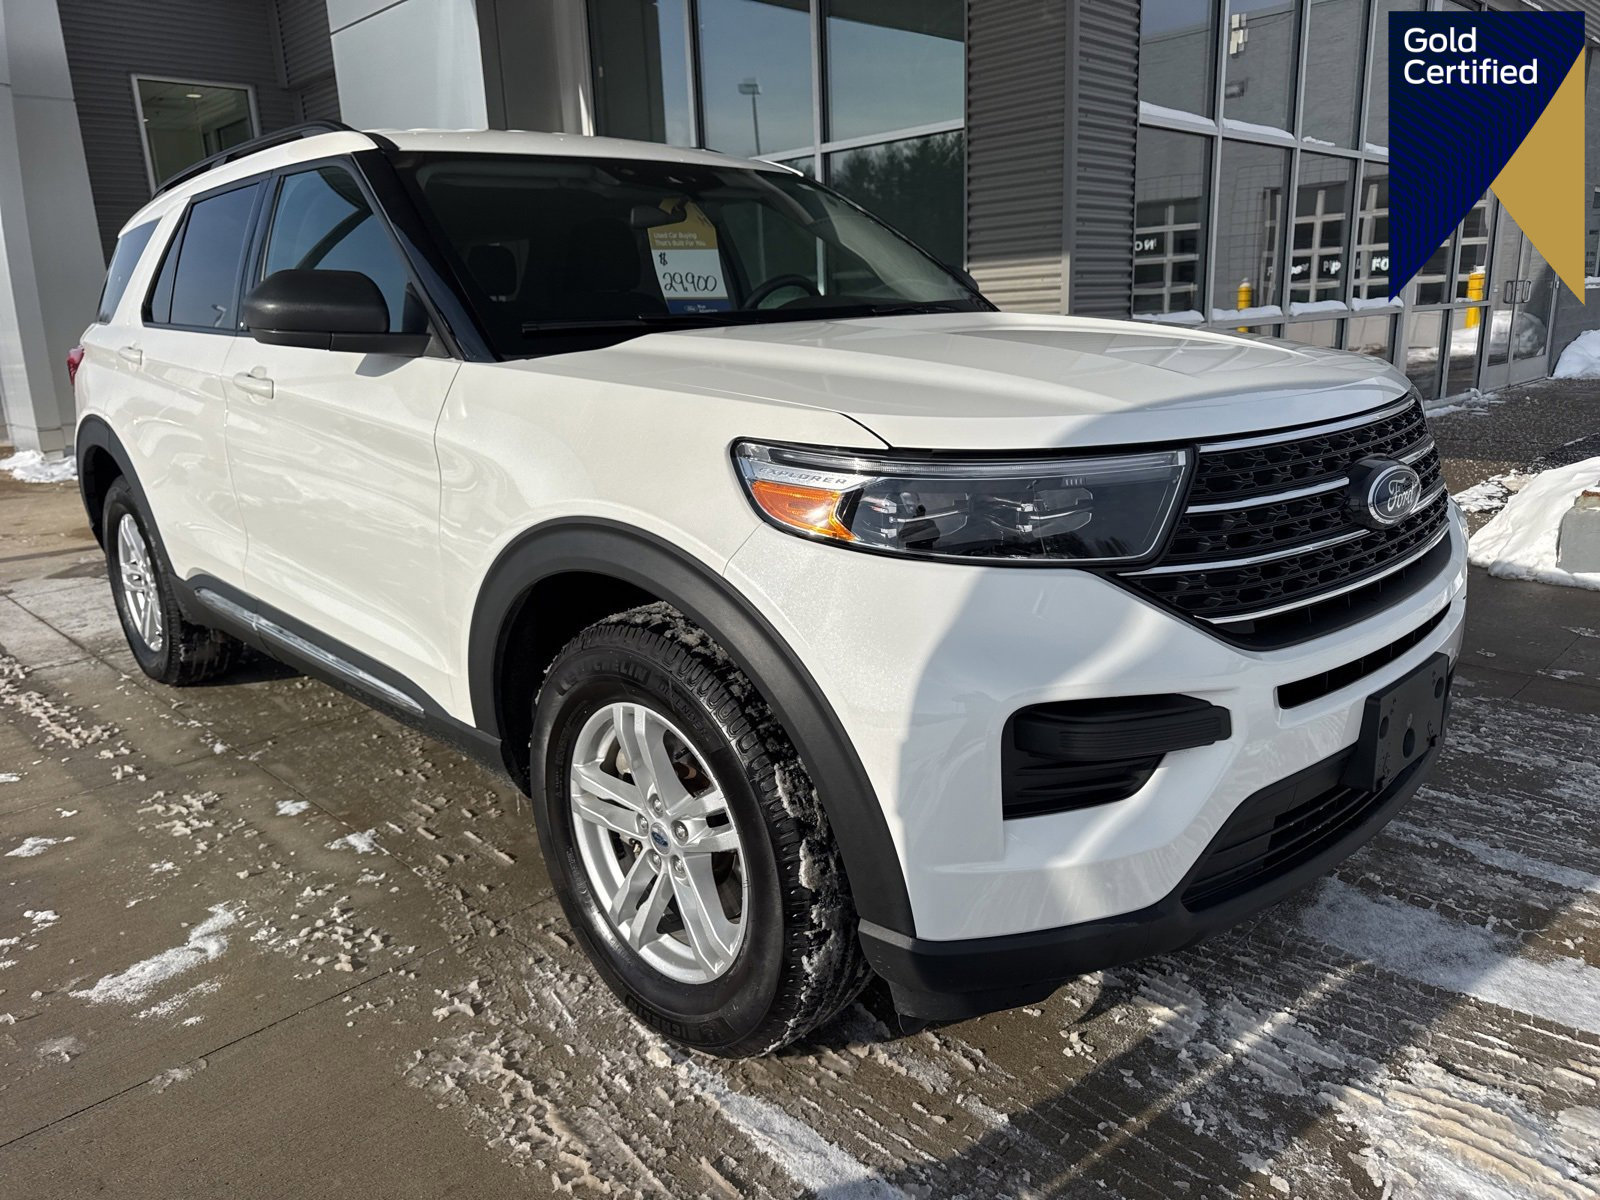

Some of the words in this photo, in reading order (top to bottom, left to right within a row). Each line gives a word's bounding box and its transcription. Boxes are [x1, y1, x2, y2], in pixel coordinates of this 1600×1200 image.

[653, 231, 668, 239] Used
[679, 231, 697, 240] Buying
[1387, 477, 1418, 512] Ford
